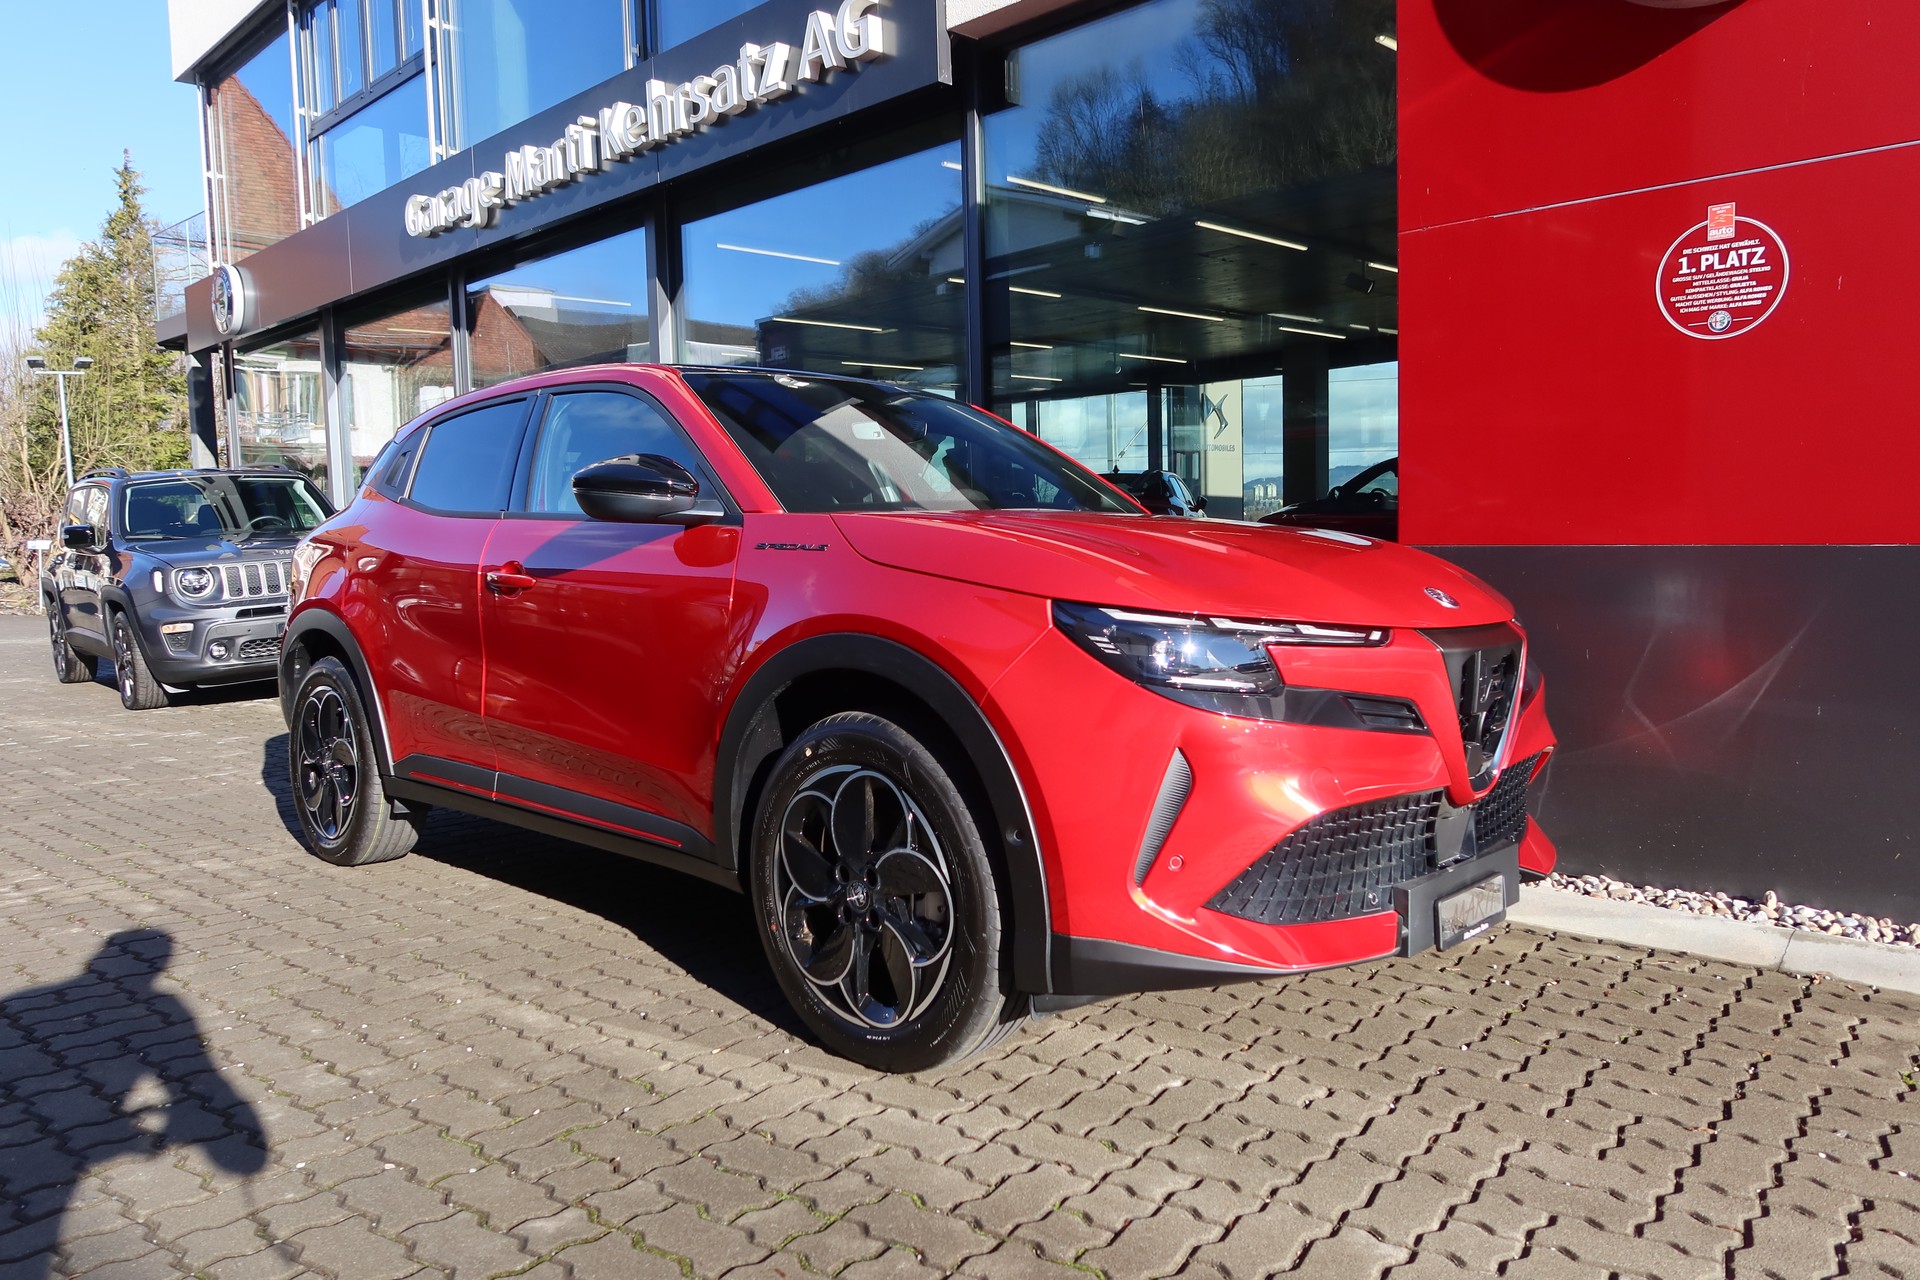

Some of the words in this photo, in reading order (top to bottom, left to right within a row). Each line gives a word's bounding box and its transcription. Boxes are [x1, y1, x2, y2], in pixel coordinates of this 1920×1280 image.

[405, 171, 505, 237] Garage
[505, 115, 599, 201] Marti
[599, 41, 792, 161] Kehrsatz
[798, 0, 883, 82] AG
[1709, 227, 1733, 236] auto
[1678, 257, 1696, 274] 1.
[1700, 247, 1766, 271] PLATZ
